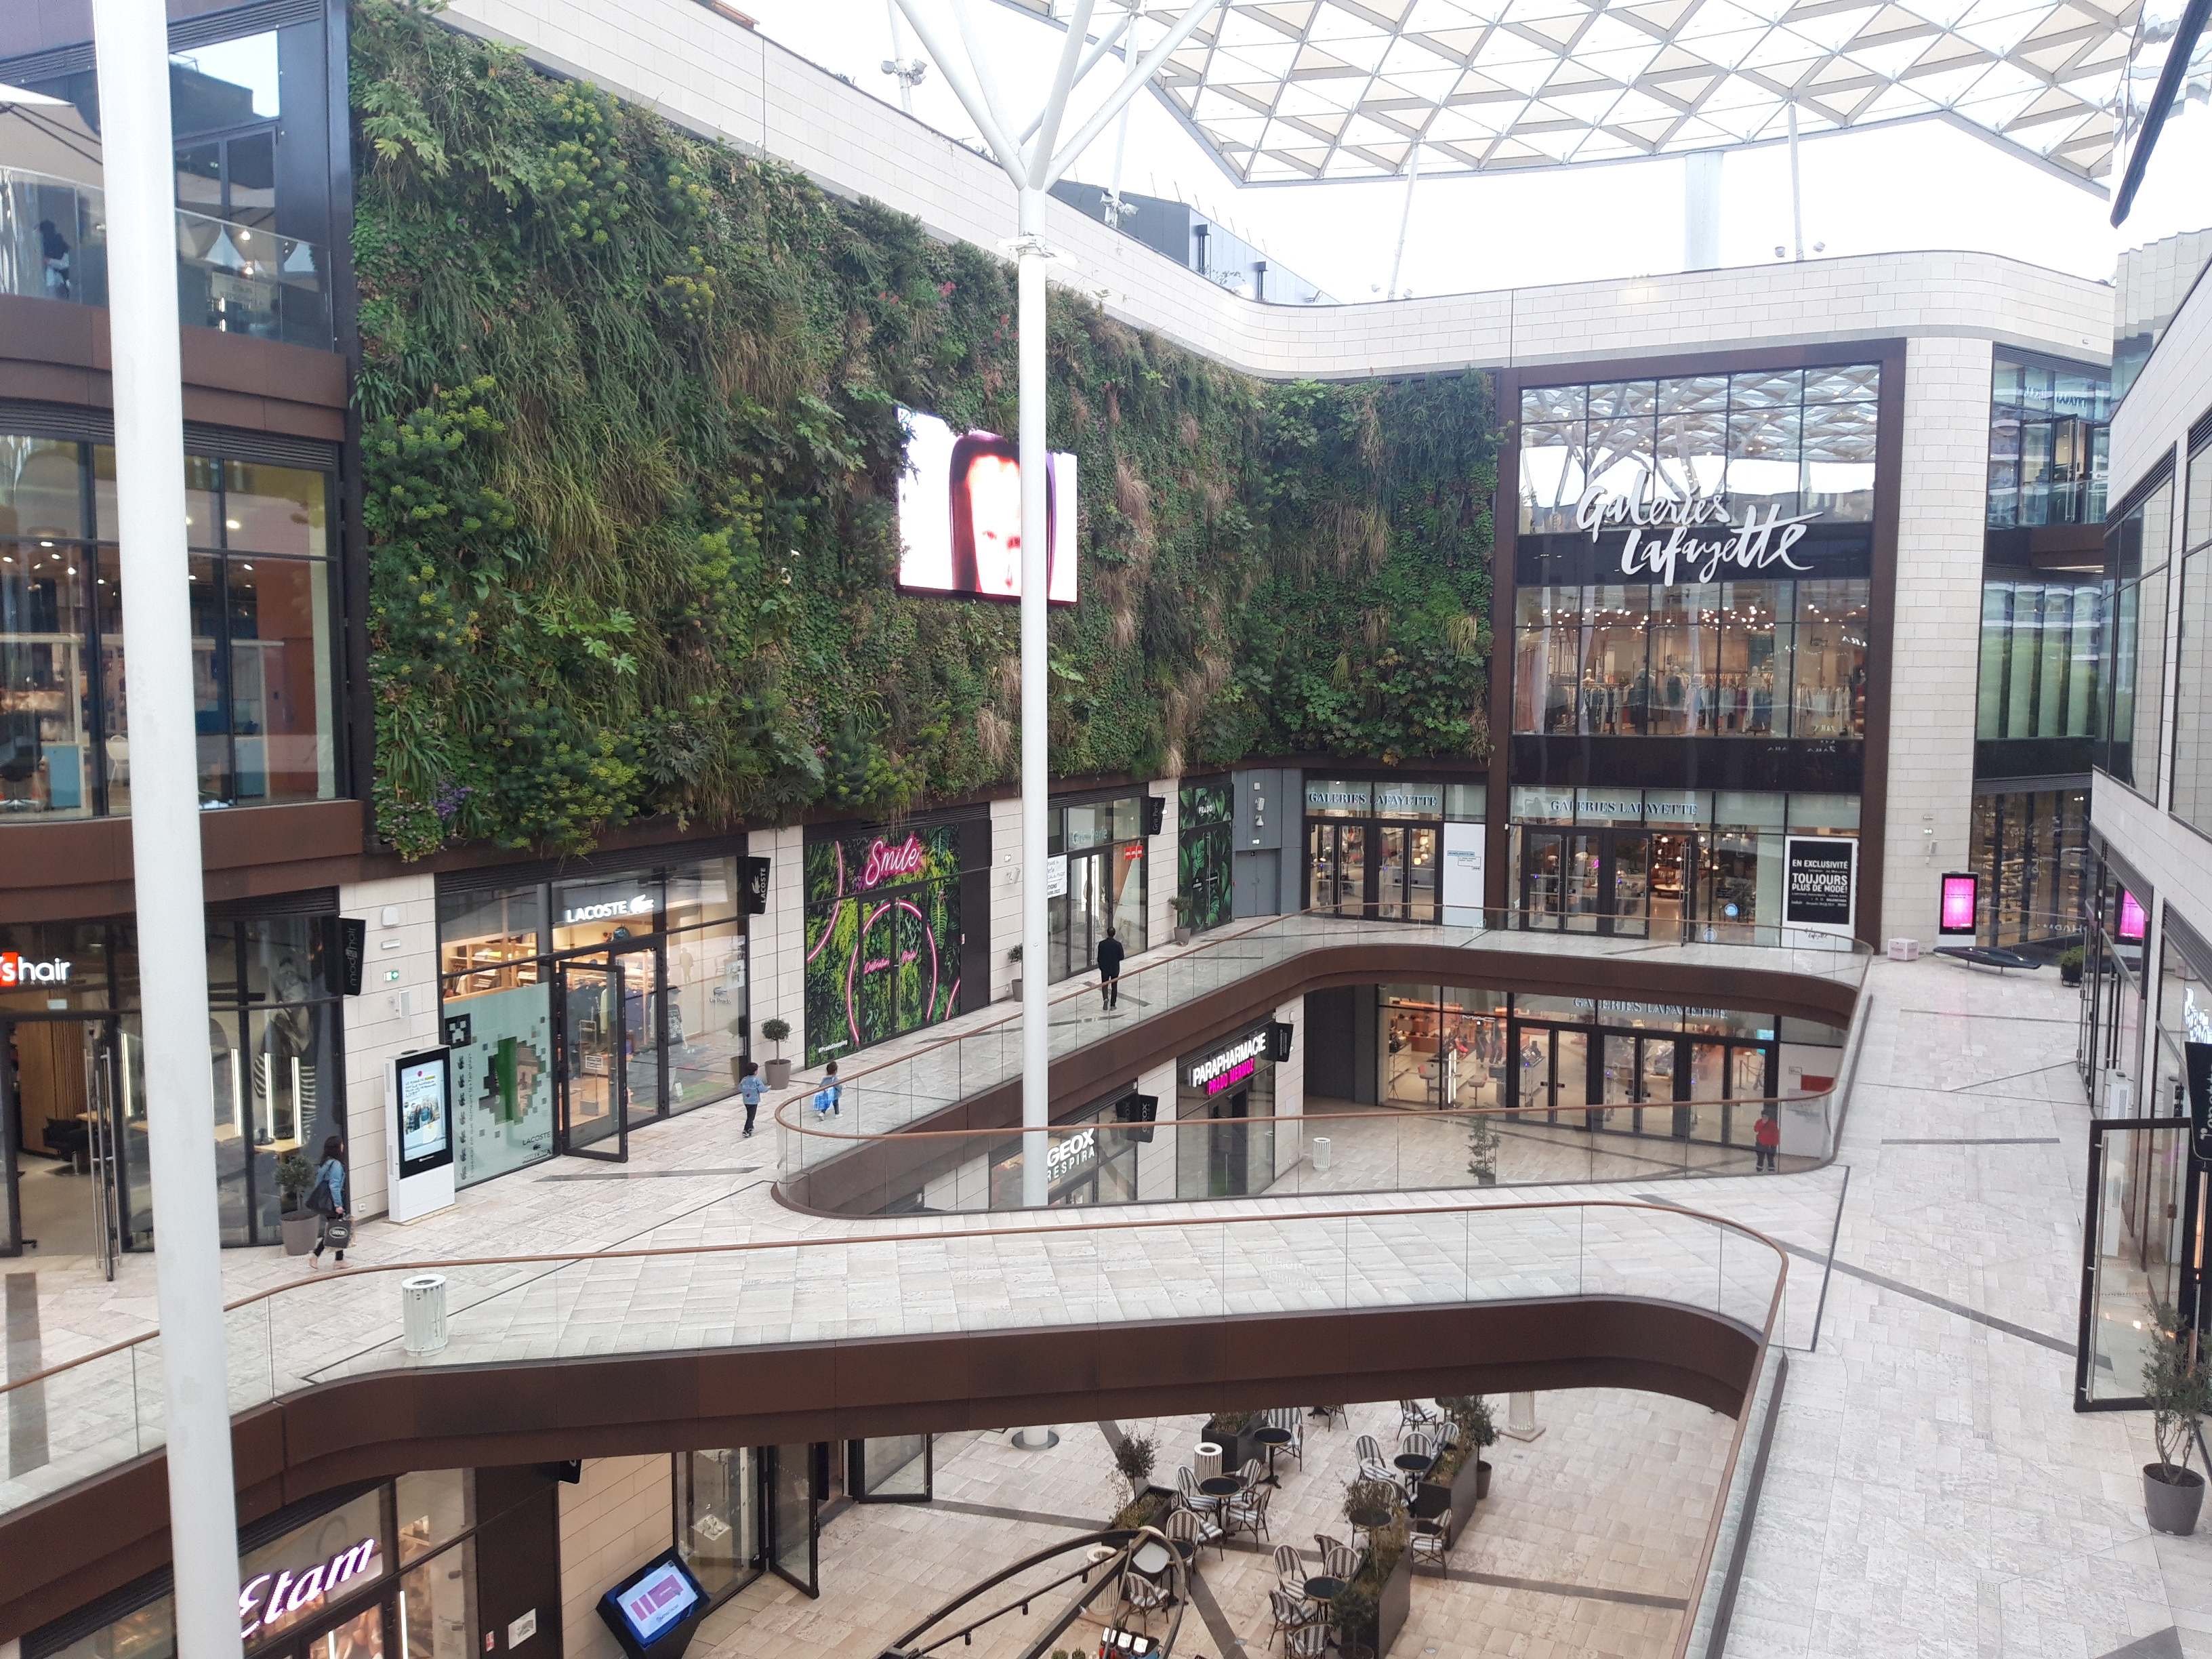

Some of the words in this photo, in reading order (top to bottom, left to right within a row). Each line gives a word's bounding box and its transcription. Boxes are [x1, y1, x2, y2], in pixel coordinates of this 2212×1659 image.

[1576, 470, 1730, 543] Galeries
[1622, 504, 1824, 587] Lafayette
[1198, 805, 1213, 814] PRADO
[1309, 792, 1366, 804] GALERIES
[865, 838, 920, 886] Smile
[1803, 860, 1848, 869] EXCLUSIVITÉ
[1792, 872, 1848, 886] TOUJOURS
[1792, 883, 1810, 891] PLUS
[1824, 885, 1848, 893] MODE!
[567, 900, 628, 923] LACOSTE
[18, 956, 71, 981] hair
[1192, 1032, 1267, 1088] PARAPHARMACIE
[1207, 1072, 1228, 1095] PRADO
[1229, 1058, 1254, 1084] MERMOZ
[523, 1131, 551, 1145] LACOSTE
[1047, 1128, 1095, 1167] GEOX
[1048, 1146, 1095, 1181] RESPIRA
[238, 1538, 375, 1639] Etam
